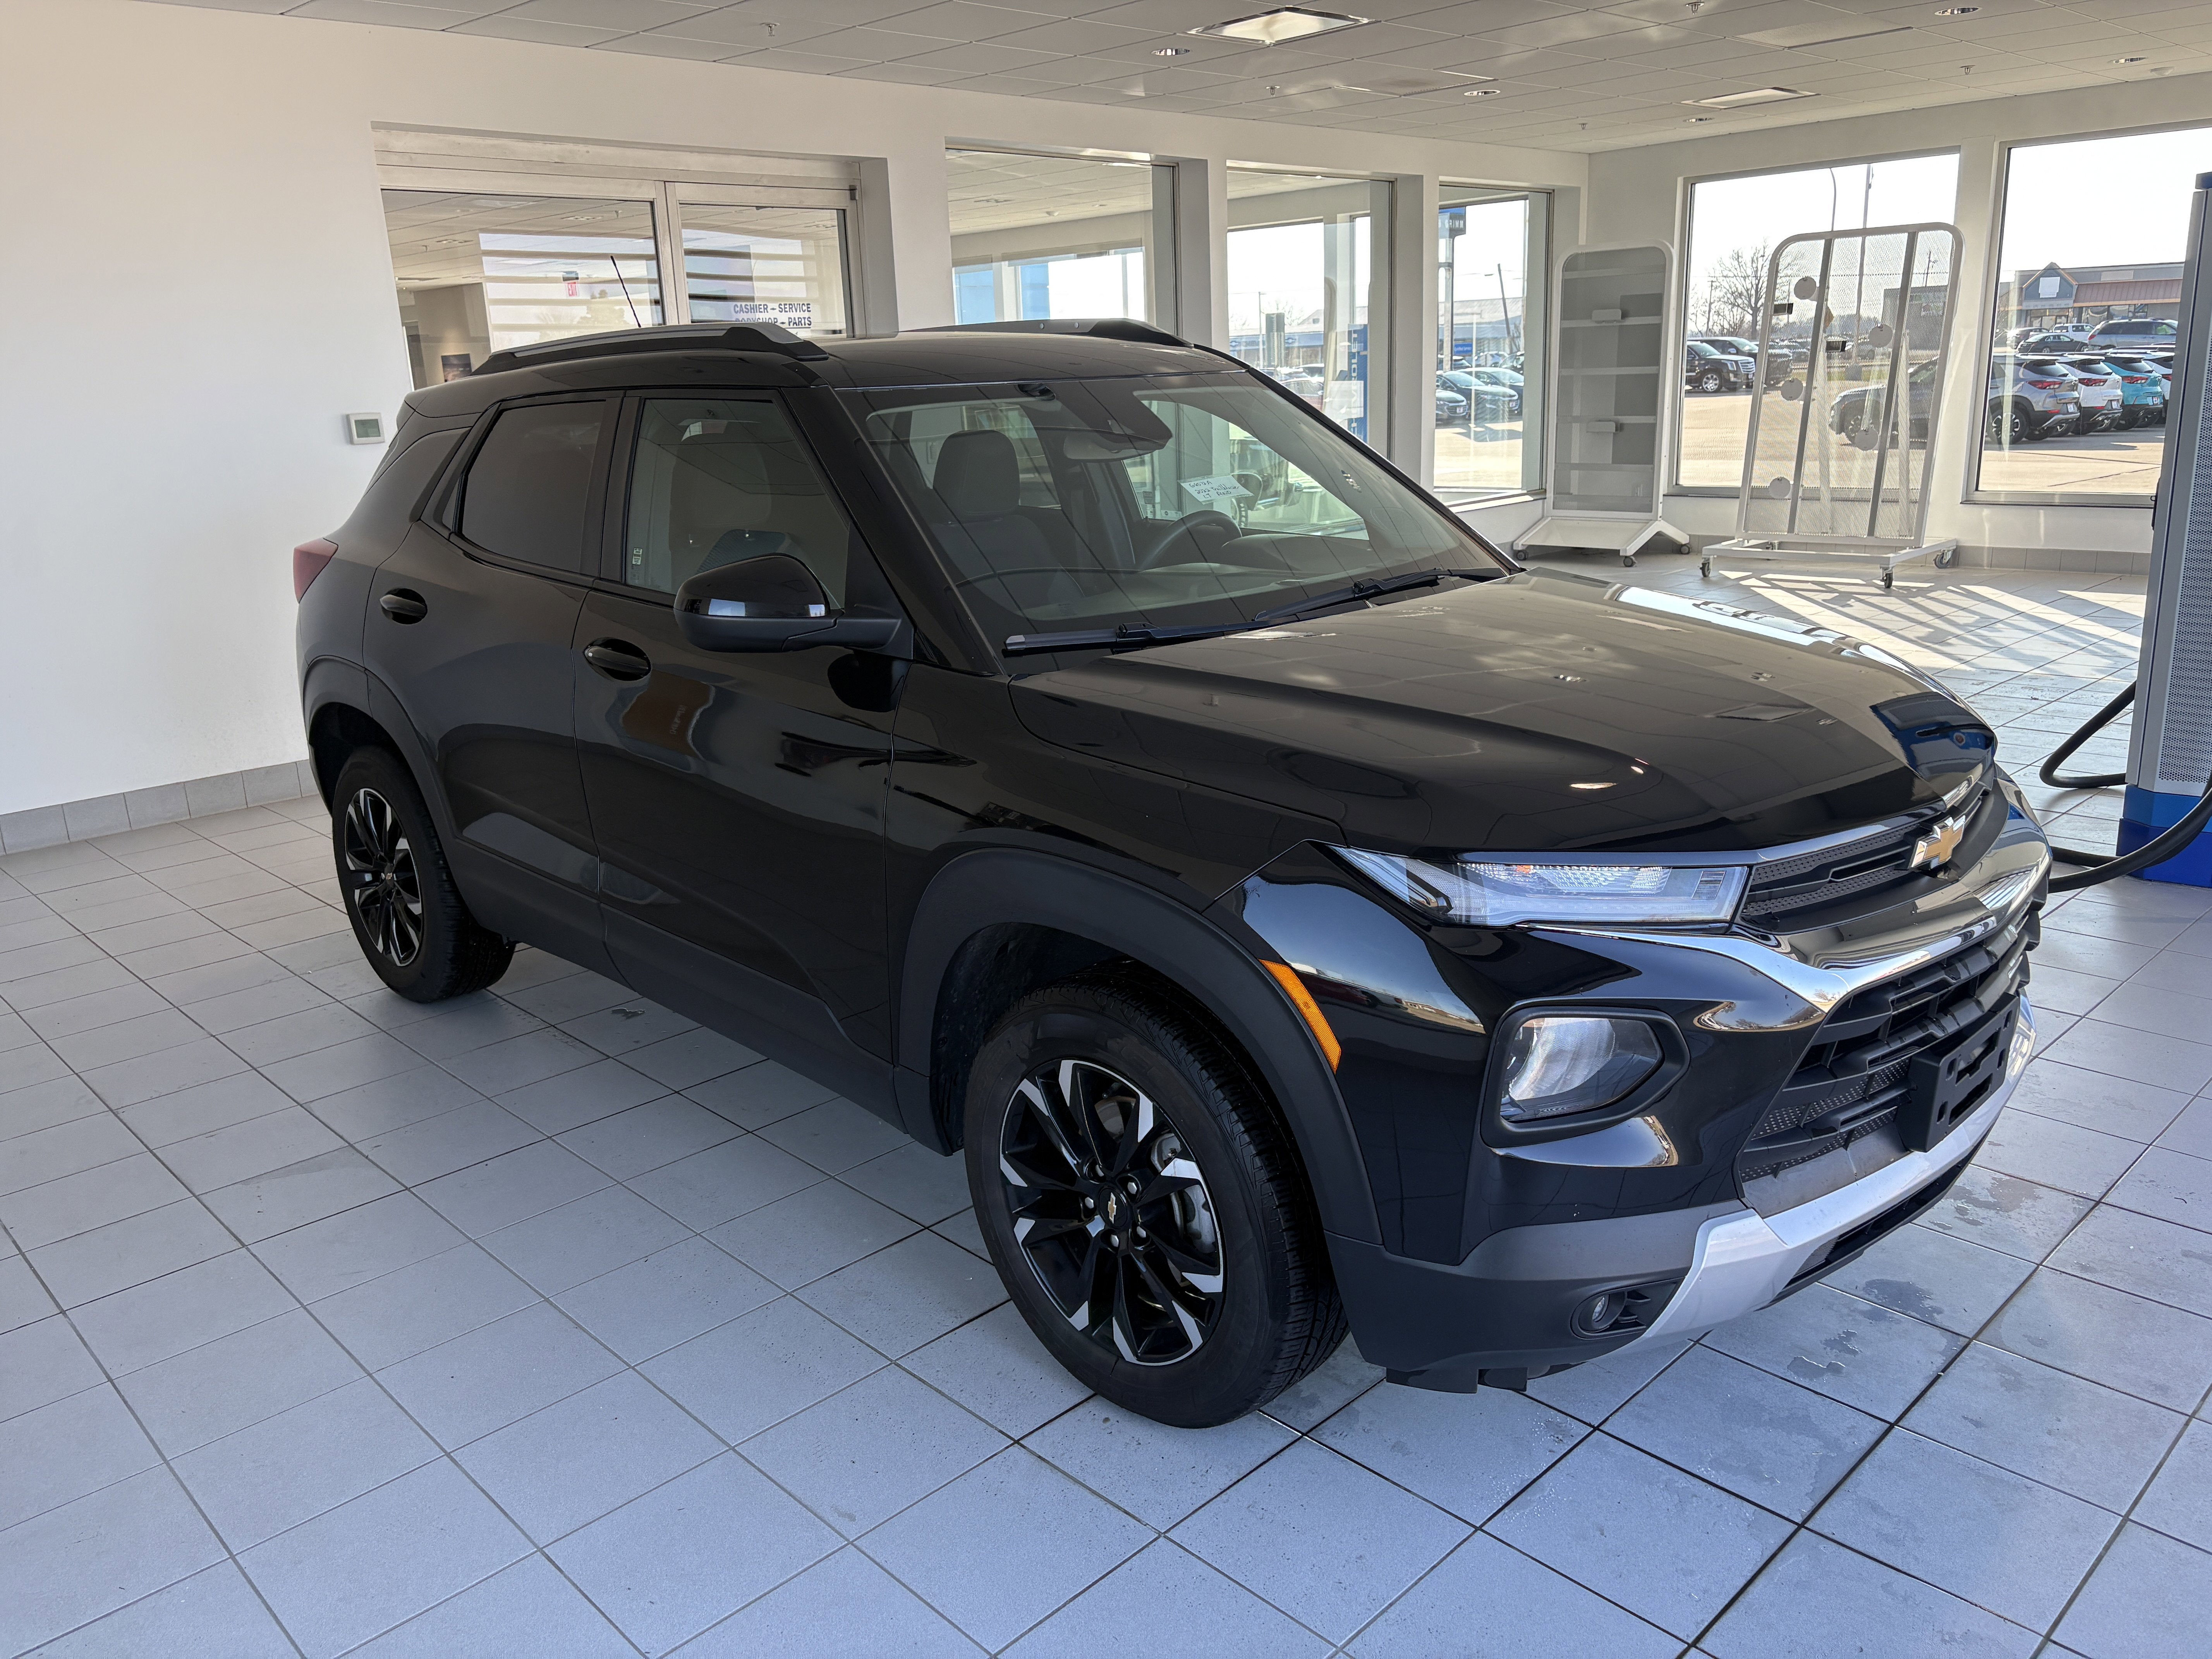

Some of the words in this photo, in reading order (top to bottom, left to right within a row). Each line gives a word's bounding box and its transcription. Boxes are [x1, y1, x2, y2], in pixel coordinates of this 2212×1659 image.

[733, 304, 769, 314] CASHIER
[778, 303, 811, 313] SERVICE
[788, 316, 812, 326] PARTS
